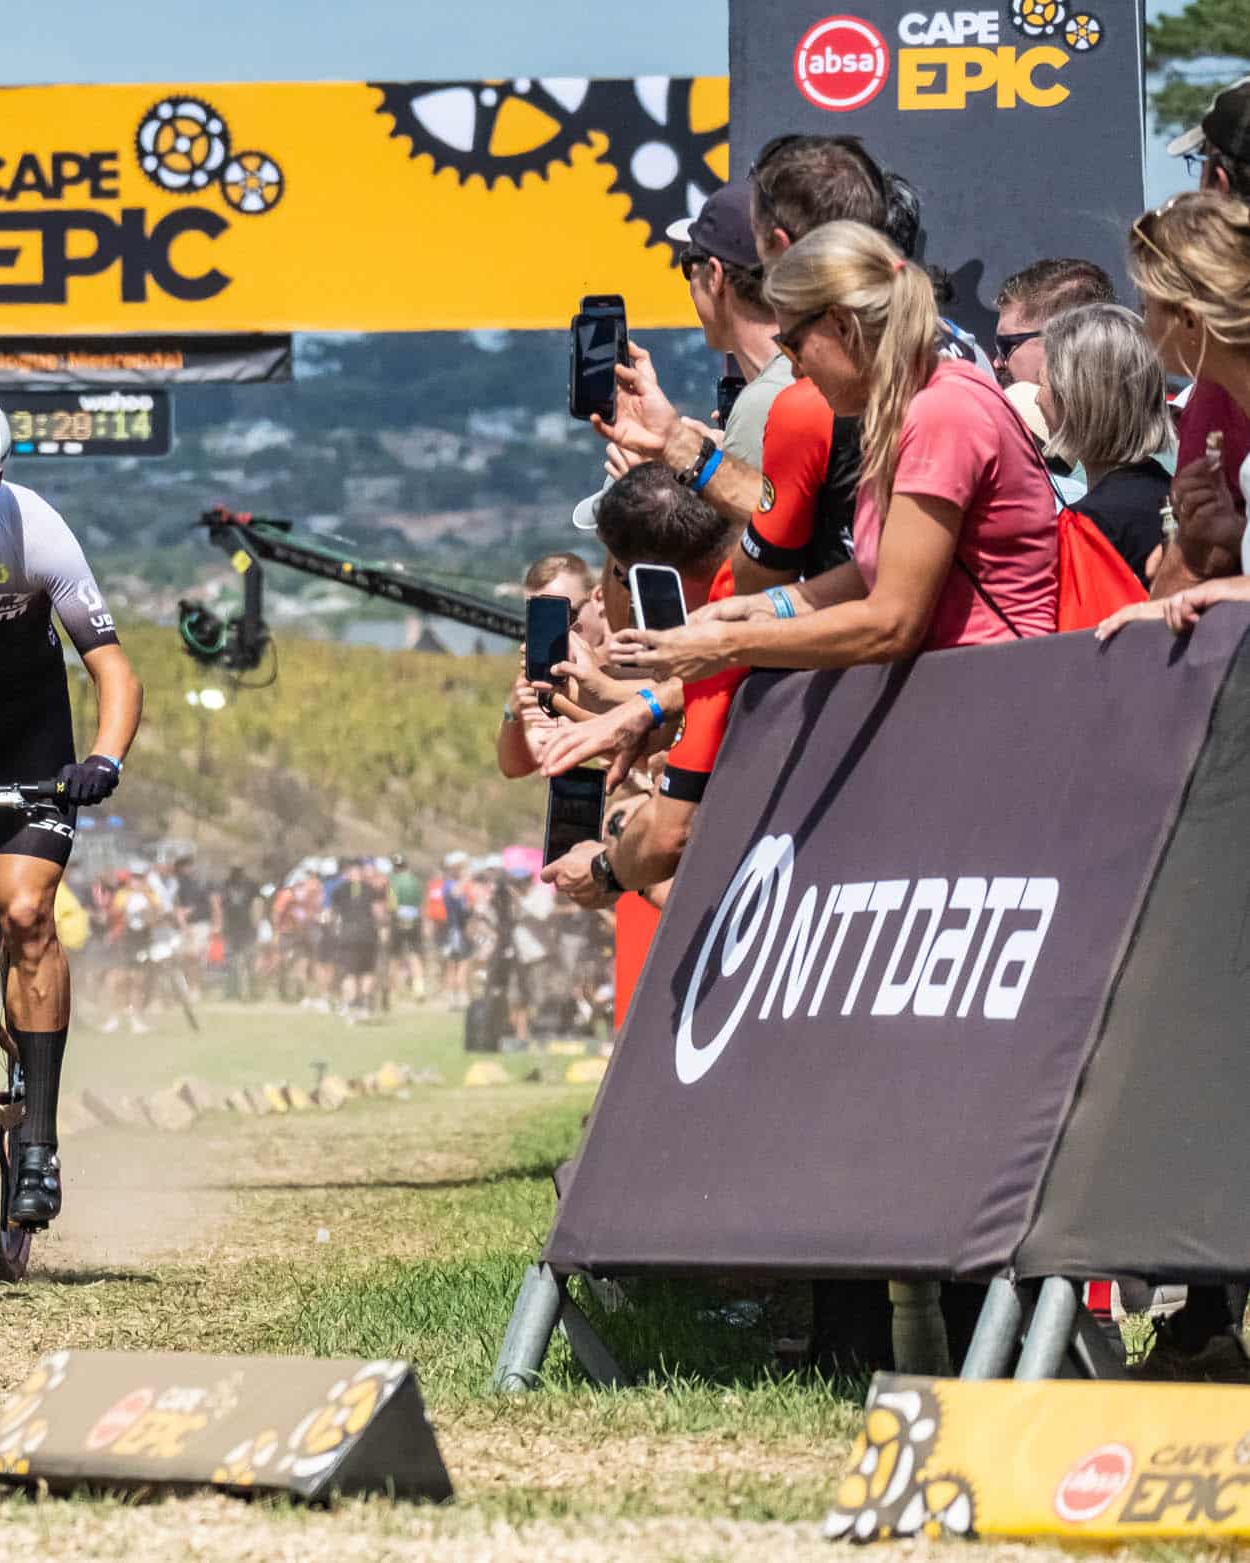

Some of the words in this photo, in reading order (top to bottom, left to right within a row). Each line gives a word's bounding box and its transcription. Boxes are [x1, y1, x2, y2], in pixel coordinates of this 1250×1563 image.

[898, 11, 999, 45] CAPE
[808, 47, 875, 74] absa
[898, 46, 1071, 110] EPIC
[78, 391, 153, 412] wahoo
[758, 879, 910, 1019] NTT
[1117, 1473, 1250, 1523] EPIC
